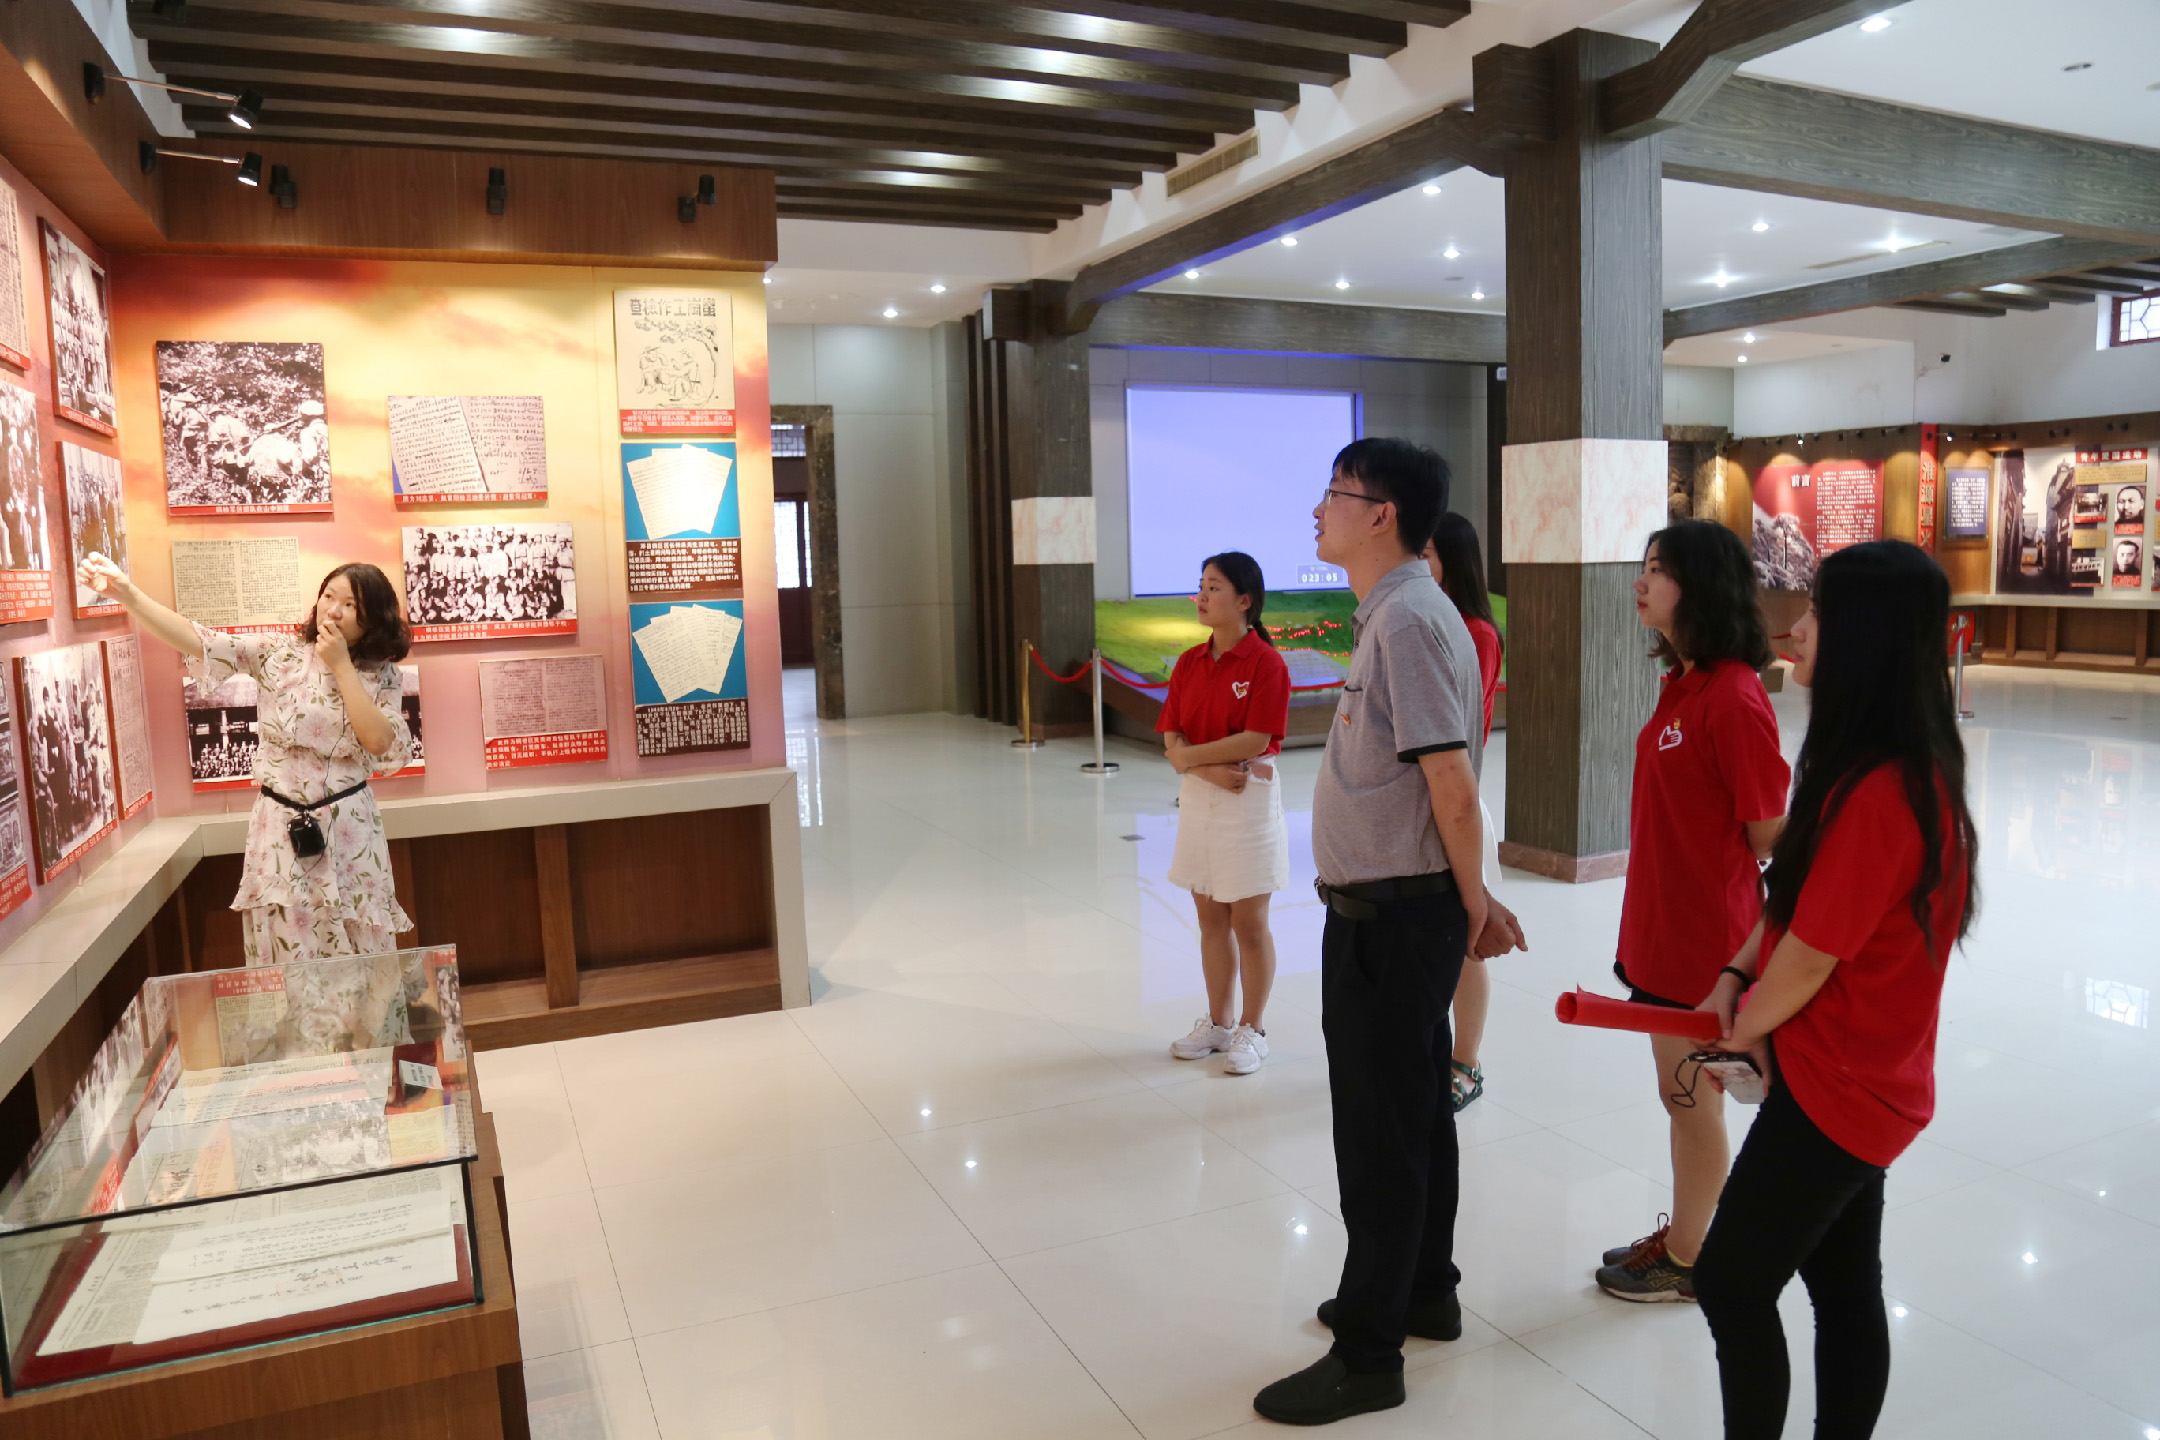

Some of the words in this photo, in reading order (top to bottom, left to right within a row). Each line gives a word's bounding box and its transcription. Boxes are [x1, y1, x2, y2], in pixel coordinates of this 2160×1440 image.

[1791, 473, 1811, 487] 前言
[1920, 461, 1935, 547] 淮源星火
